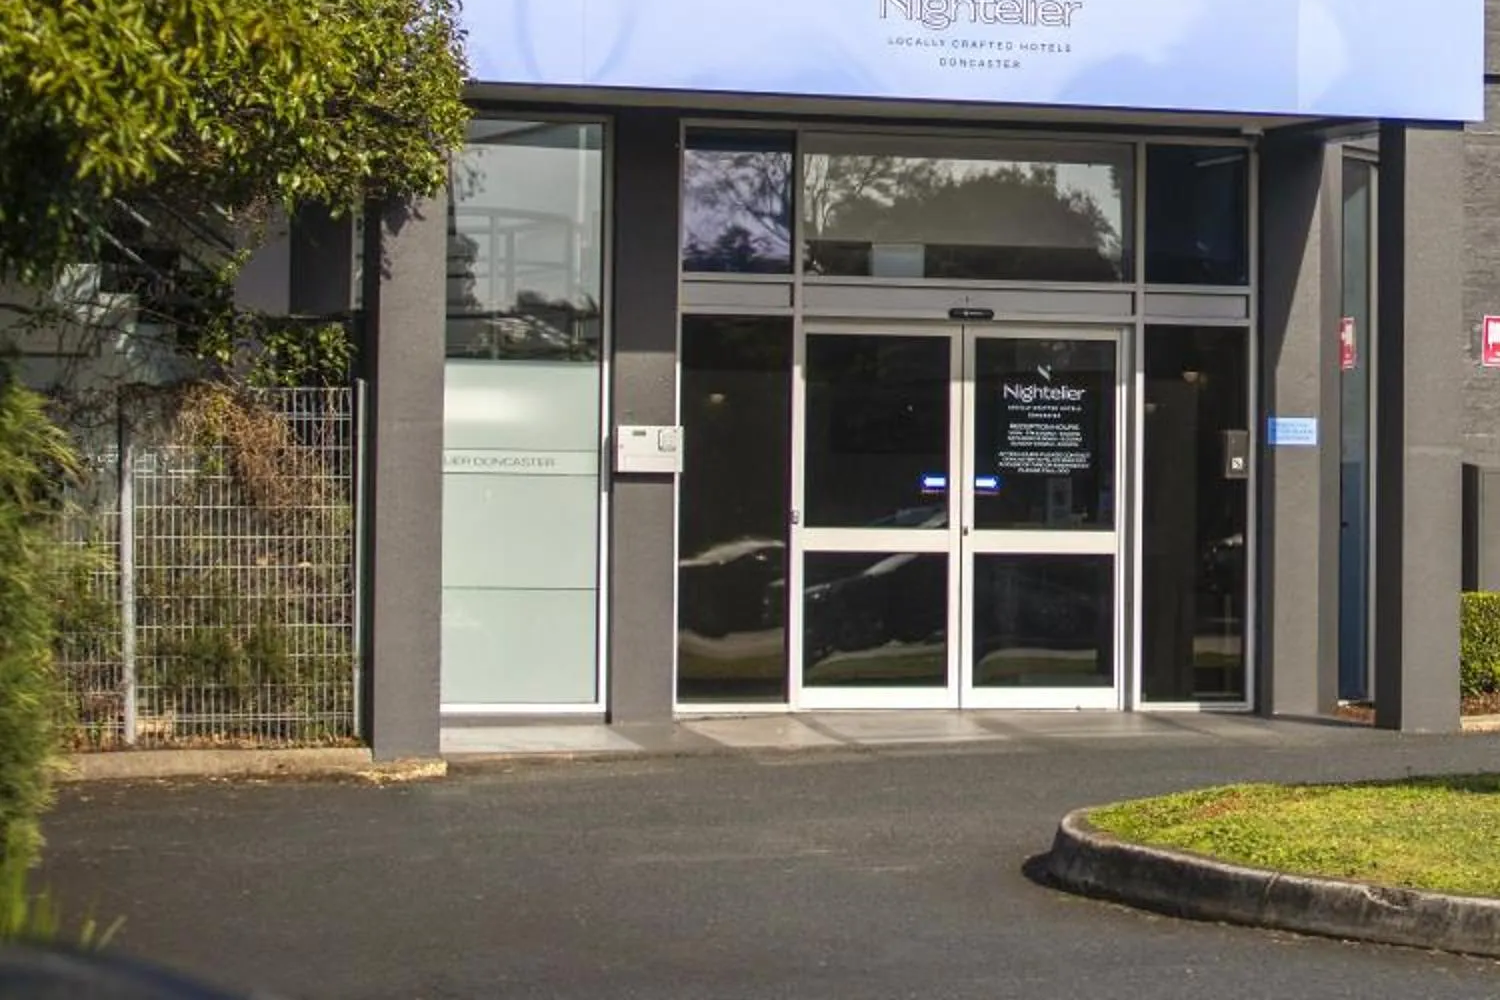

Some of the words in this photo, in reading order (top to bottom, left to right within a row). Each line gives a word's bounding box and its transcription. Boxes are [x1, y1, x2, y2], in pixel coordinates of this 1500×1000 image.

[887, 36, 945, 47] LOCALLY
[951, 39, 1013, 51] CRAFTED
[1020, 42, 1072, 53] HOTELS
[939, 57, 1021, 69] DONCASTER
[1003, 383, 1087, 402] Nightelier
